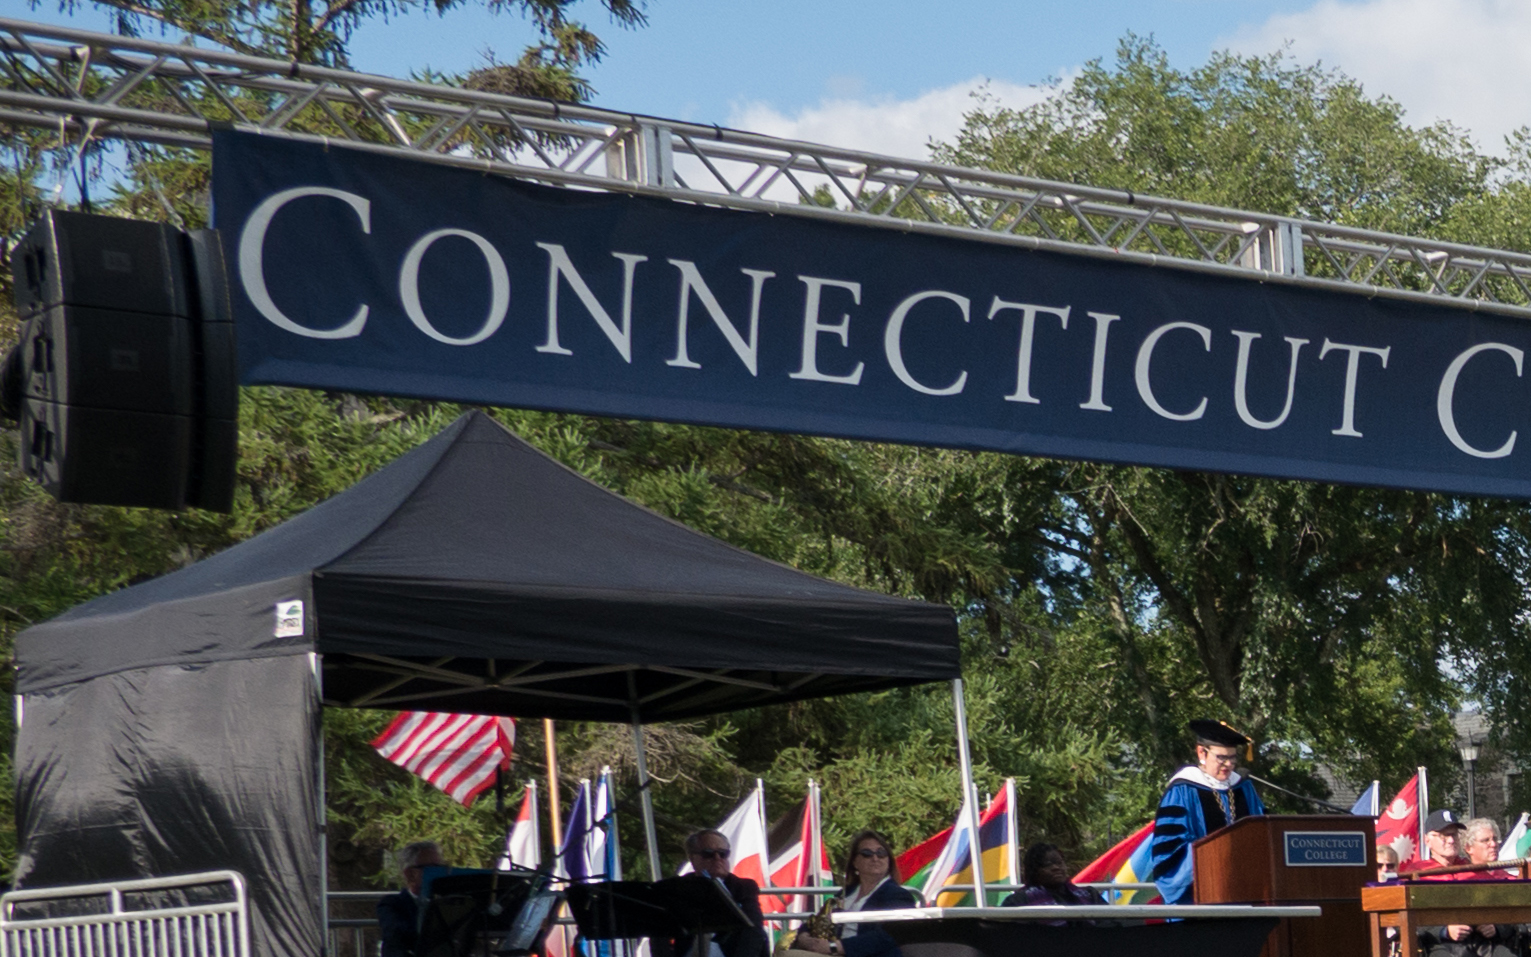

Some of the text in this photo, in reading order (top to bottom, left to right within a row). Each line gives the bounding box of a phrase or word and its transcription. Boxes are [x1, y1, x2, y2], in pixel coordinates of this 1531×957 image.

[238, 186, 1391, 438] CONNECTICUT
[1290, 837, 1360, 849] CONNECTICUT
[1304, 849, 1349, 861] COLLEGE
